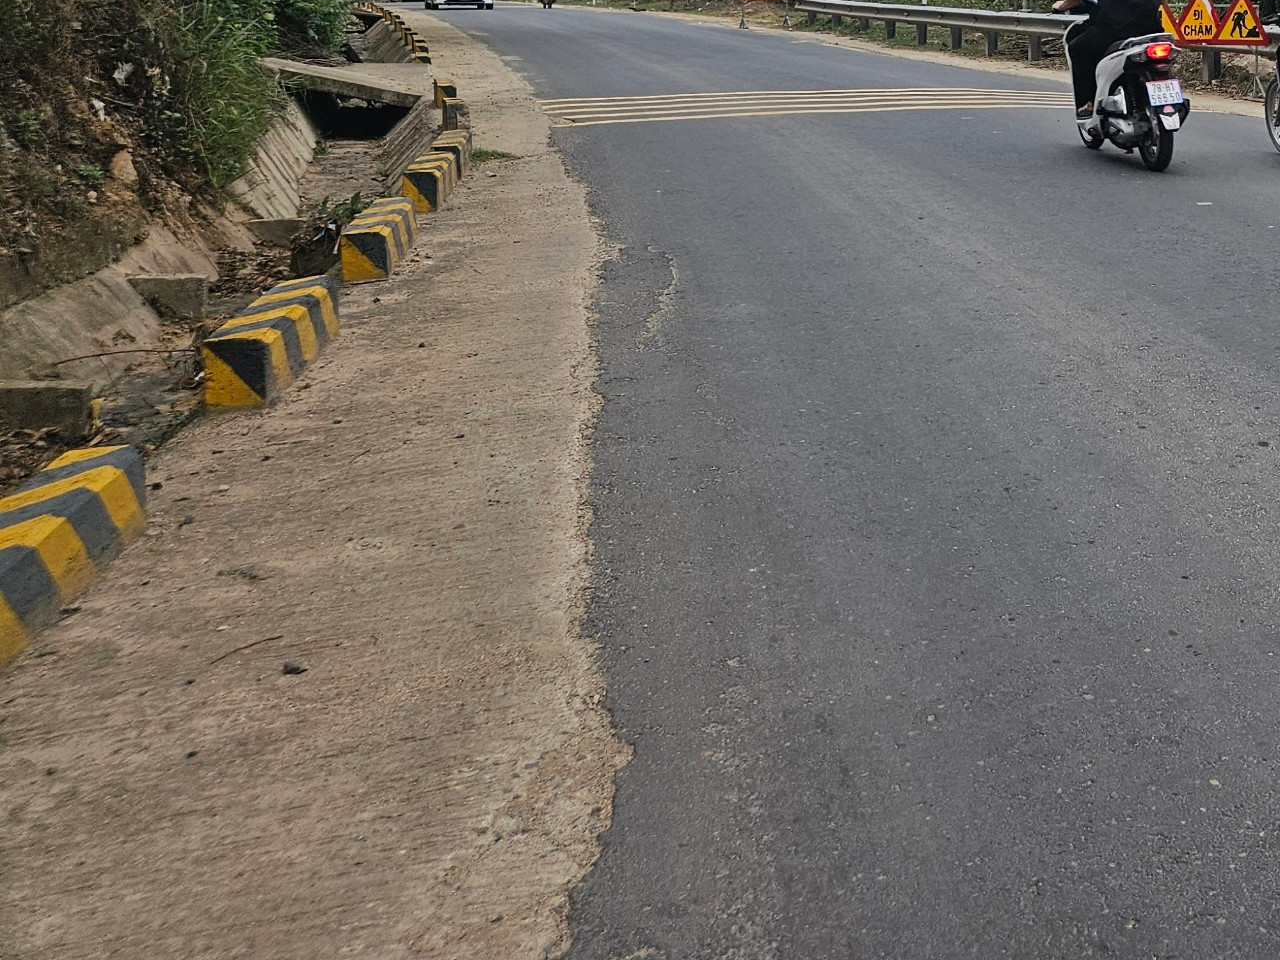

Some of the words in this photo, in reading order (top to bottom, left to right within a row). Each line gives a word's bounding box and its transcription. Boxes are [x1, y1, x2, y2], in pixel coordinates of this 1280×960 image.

[1193, 10, 1202, 20] ĐI
[1184, 23, 1212, 38] CHẬM
[1152, 82, 1174, 93] 78-H1
